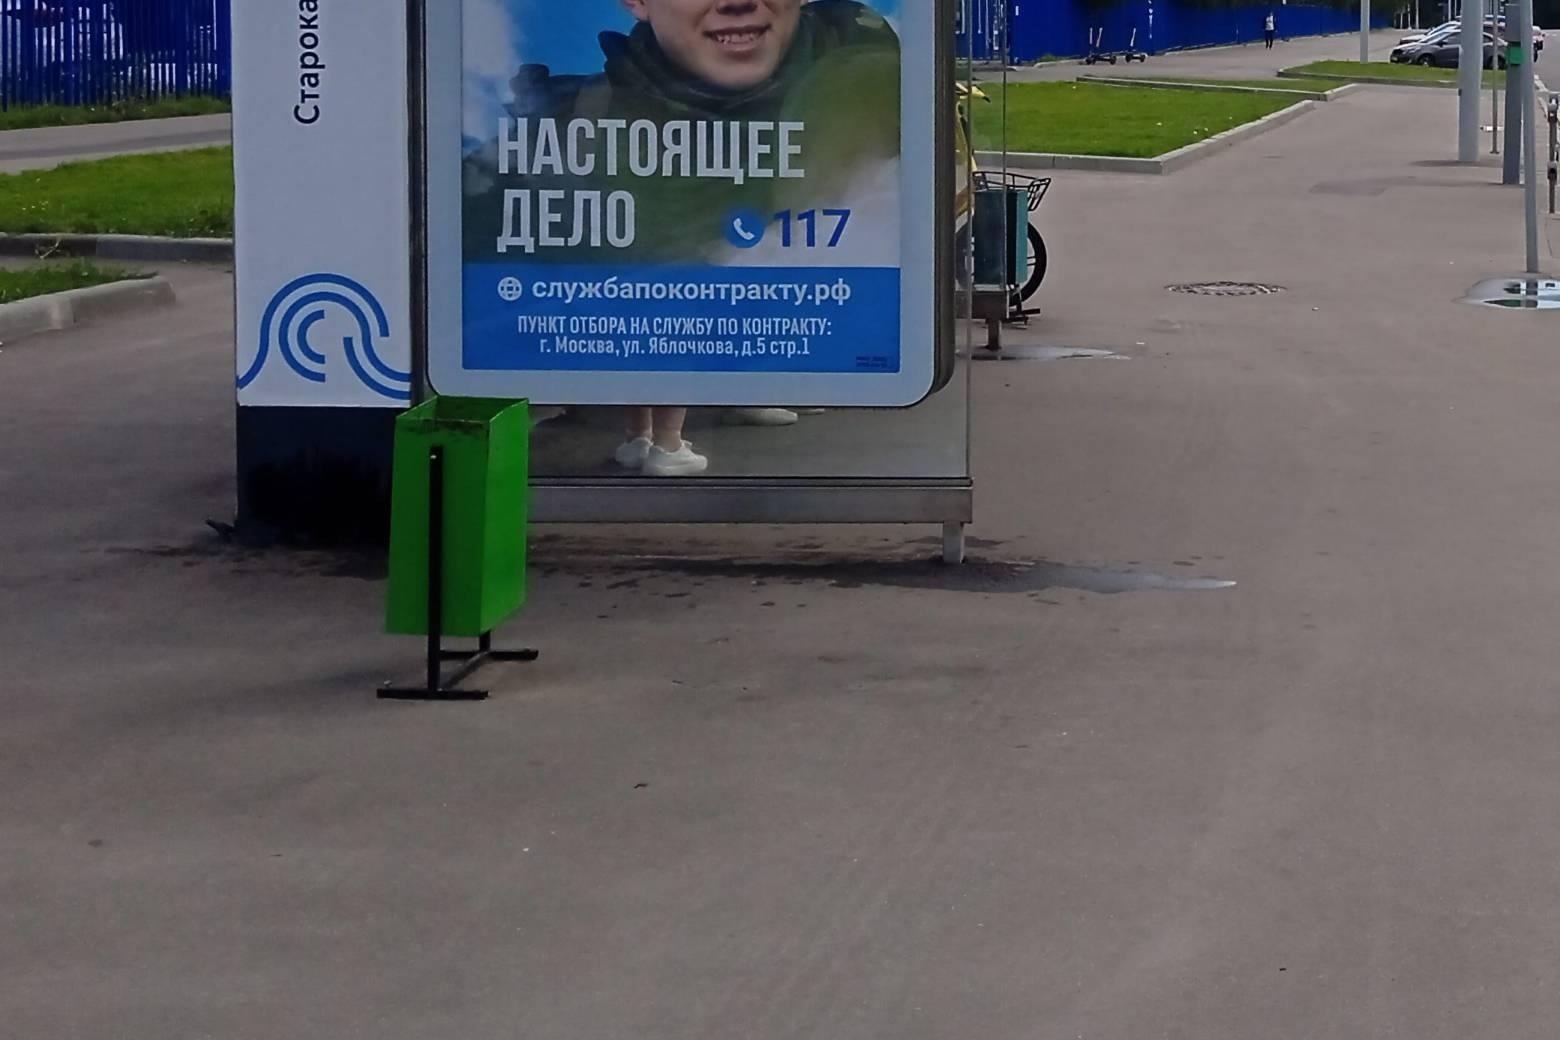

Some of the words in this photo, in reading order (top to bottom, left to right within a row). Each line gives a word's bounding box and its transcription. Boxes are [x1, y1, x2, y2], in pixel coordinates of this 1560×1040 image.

[498, 117, 805, 185] НАСТОЯЩЕЕ
[497, 189, 635, 253] ДЕЛО
[774, 208, 851, 248] 117
[531, 276, 851, 306] службапоконтракту.рф
[518, 315, 567, 334] ПУНКТ
[569, 316, 627, 335] ОТБОРА
[630, 317, 650, 335] НА
[653, 317, 714, 336] СЛУЖБУ
[718, 318, 738, 335] ПО
[742, 318, 832, 336] КОНТРАКТУ:
[540, 338, 551, 353] г.
[555, 336, 620, 356] Москва,
[622, 339, 645, 358] ул.
[649, 337, 739, 358] Яблочкова,
[741, 338, 766, 357] д.5
[770, 337, 811, 359] стр.1
